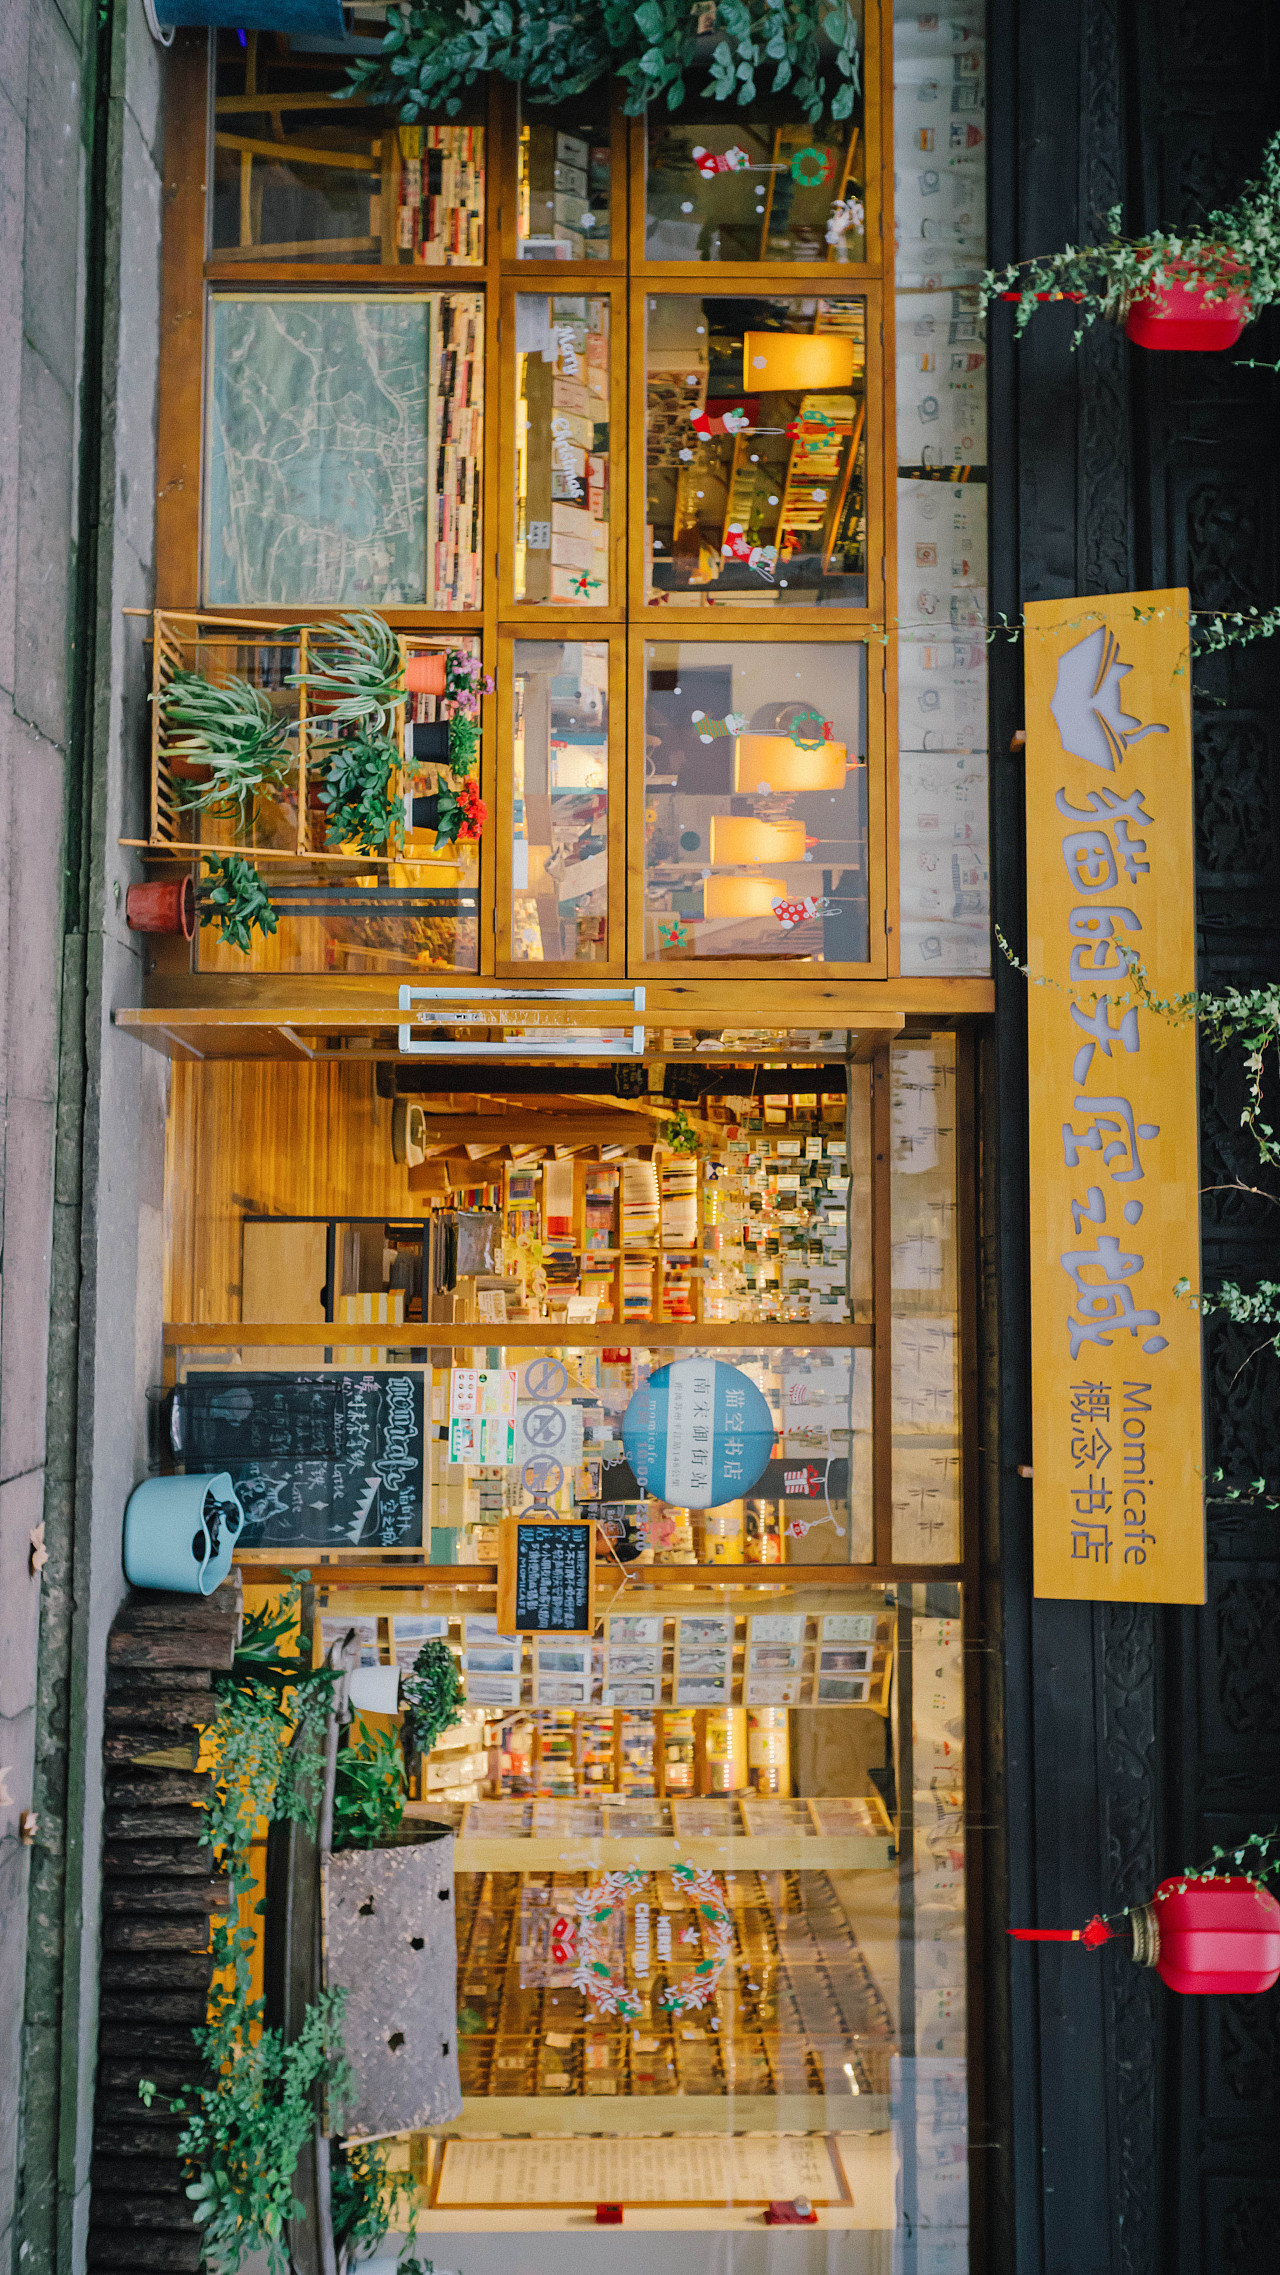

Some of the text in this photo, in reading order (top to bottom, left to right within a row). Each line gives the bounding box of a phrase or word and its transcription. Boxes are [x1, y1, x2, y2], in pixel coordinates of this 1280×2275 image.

[551, 325, 585, 500] Merry Christmas
[1057, 787, 1171, 1361] 猫的天空之城
[646, 1400, 659, 1465] momicafe
[690, 1377, 711, 1490] 南宋御街站
[722, 1388, 745, 1481] 猫空书店
[1068, 1379, 1113, 1562] 概念书店
[1118, 1379, 1155, 1566] Momicafe
[292, 1481, 309, 1514] Latte
[332, 1463, 346, 1501] Latte
[517, 1557, 527, 1616] MOMICAFE
[634, 1902, 650, 1979] CHRISTMAS
[656, 1915, 672, 1963] MERRY
